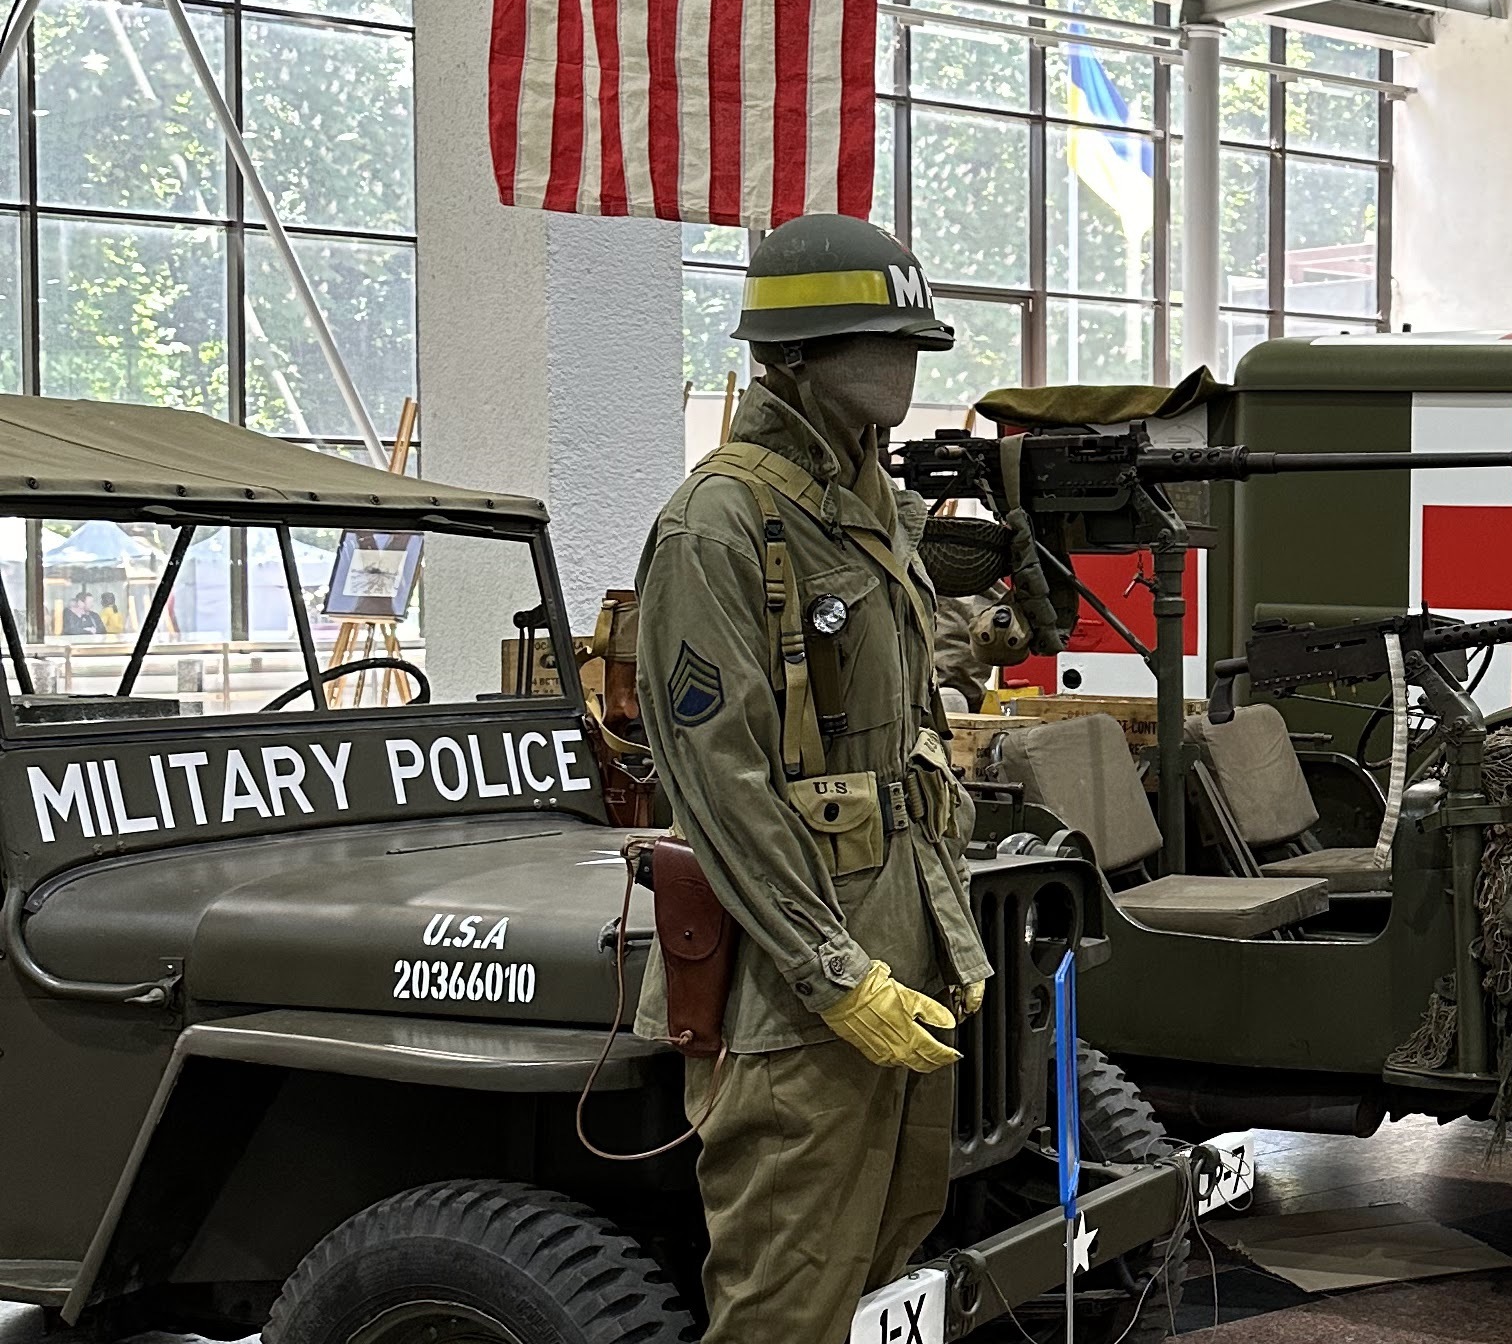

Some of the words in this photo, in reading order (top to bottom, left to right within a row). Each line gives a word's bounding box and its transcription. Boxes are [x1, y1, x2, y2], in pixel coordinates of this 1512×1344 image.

[888, 263, 932, 310] M
[26, 742, 352, 842] MILITARY
[385, 729, 592, 805] POLICE
[812, 780, 853, 795] U.S.
[423, 913, 510, 950] U.S.A
[394, 960, 535, 1003] 20366010
